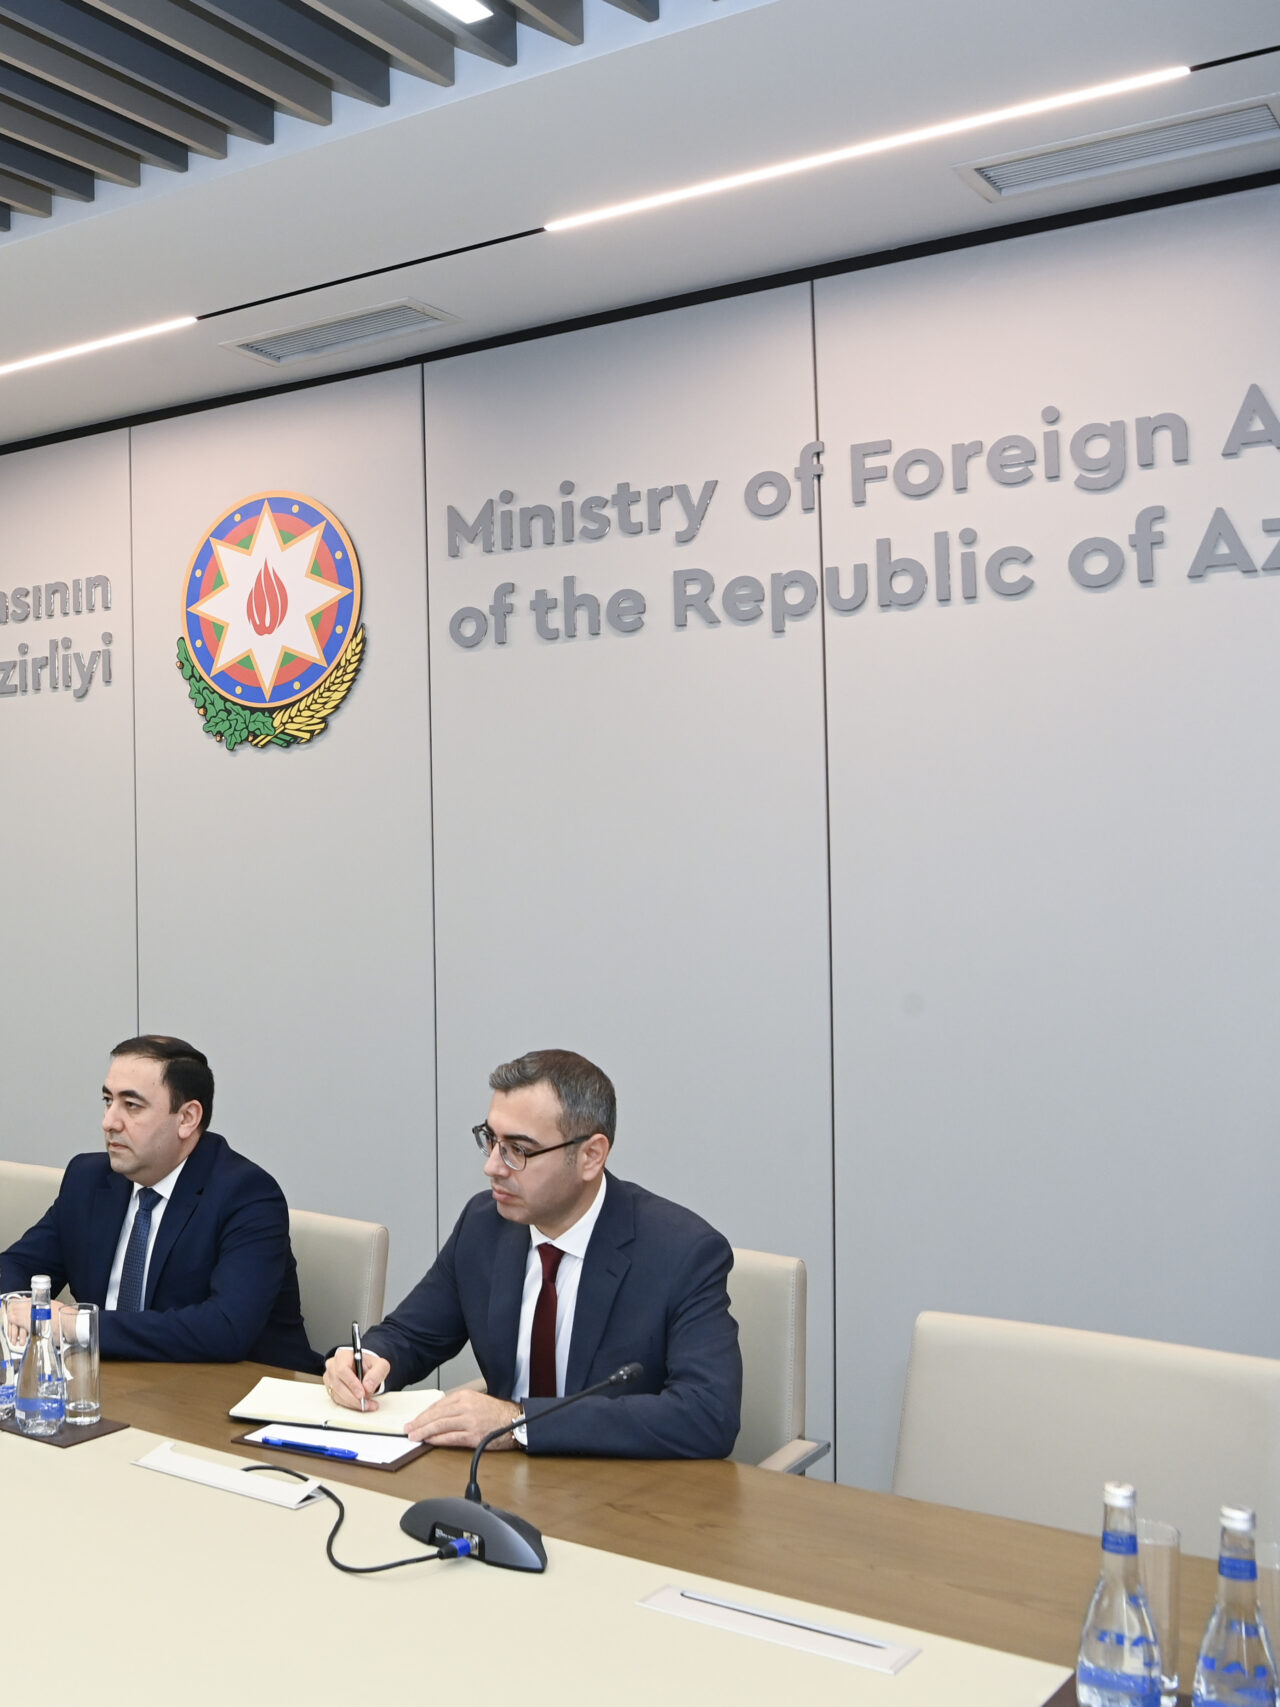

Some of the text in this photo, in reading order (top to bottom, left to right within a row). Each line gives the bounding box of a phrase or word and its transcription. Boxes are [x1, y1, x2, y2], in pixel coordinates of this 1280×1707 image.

[447, 480, 718, 558] Ministry
[744, 440, 825, 519] of
[850, 405, 1190, 505] Foreign
[449, 581, 516, 649] of
[529, 575, 646, 643] the
[673, 527, 1035, 634] Republic
[1068, 504, 1167, 590] of
